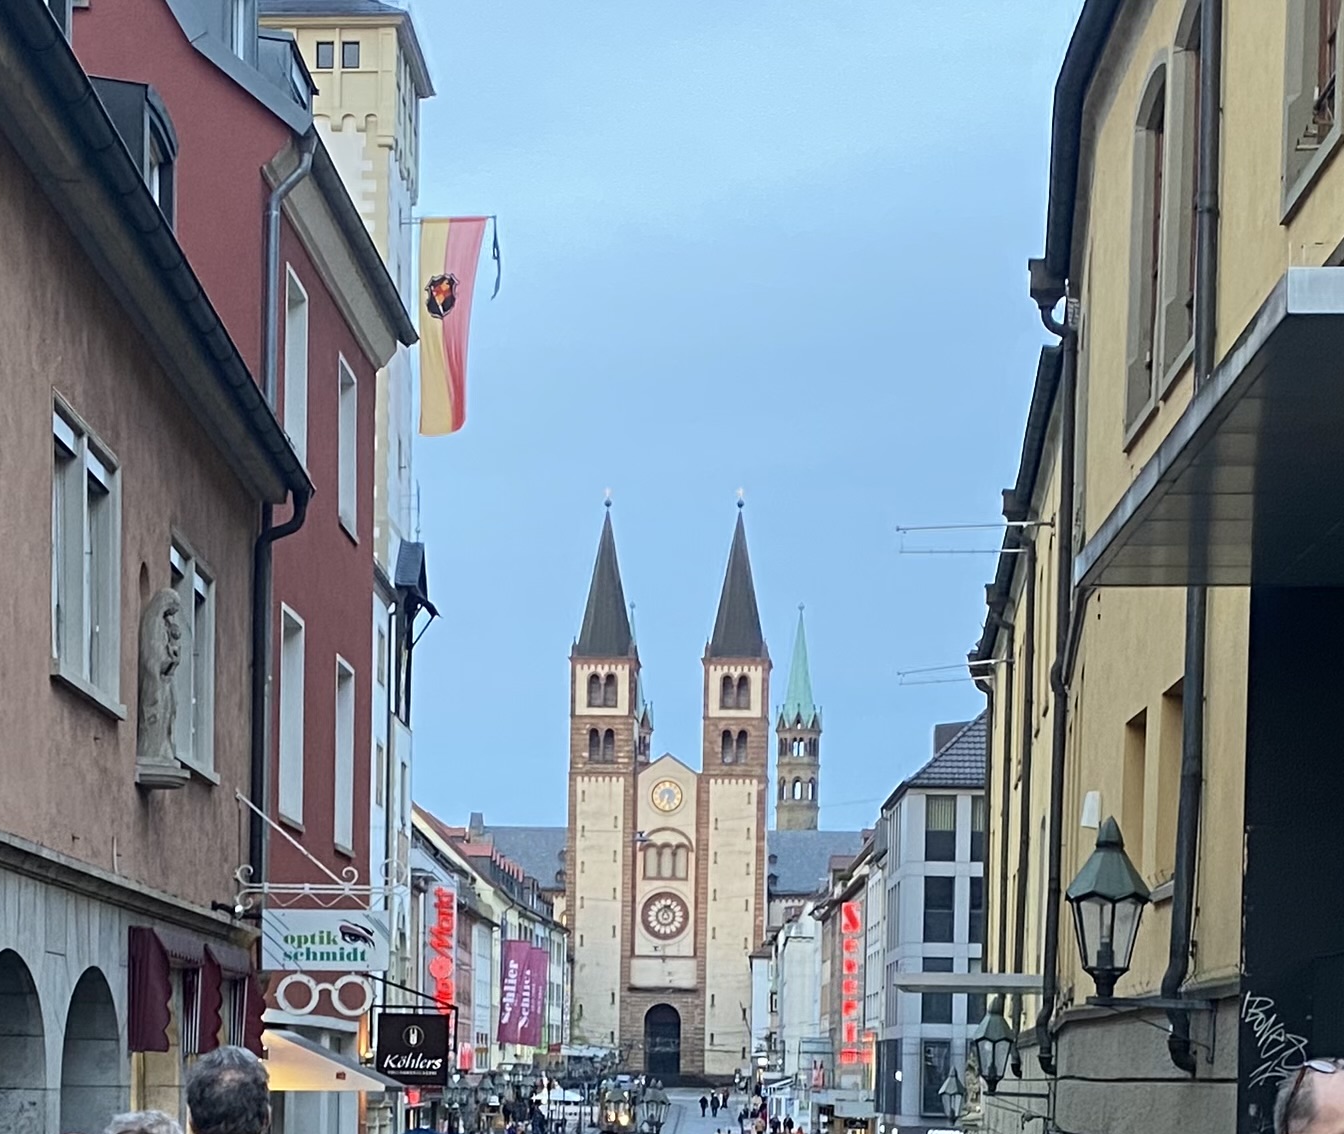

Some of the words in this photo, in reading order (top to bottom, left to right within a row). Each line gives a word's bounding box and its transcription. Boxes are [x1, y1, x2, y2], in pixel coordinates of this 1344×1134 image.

[283, 930, 338, 948] optik
[283, 947, 367, 962] schmidt
[383, 1052, 443, 1070] Köhlers
